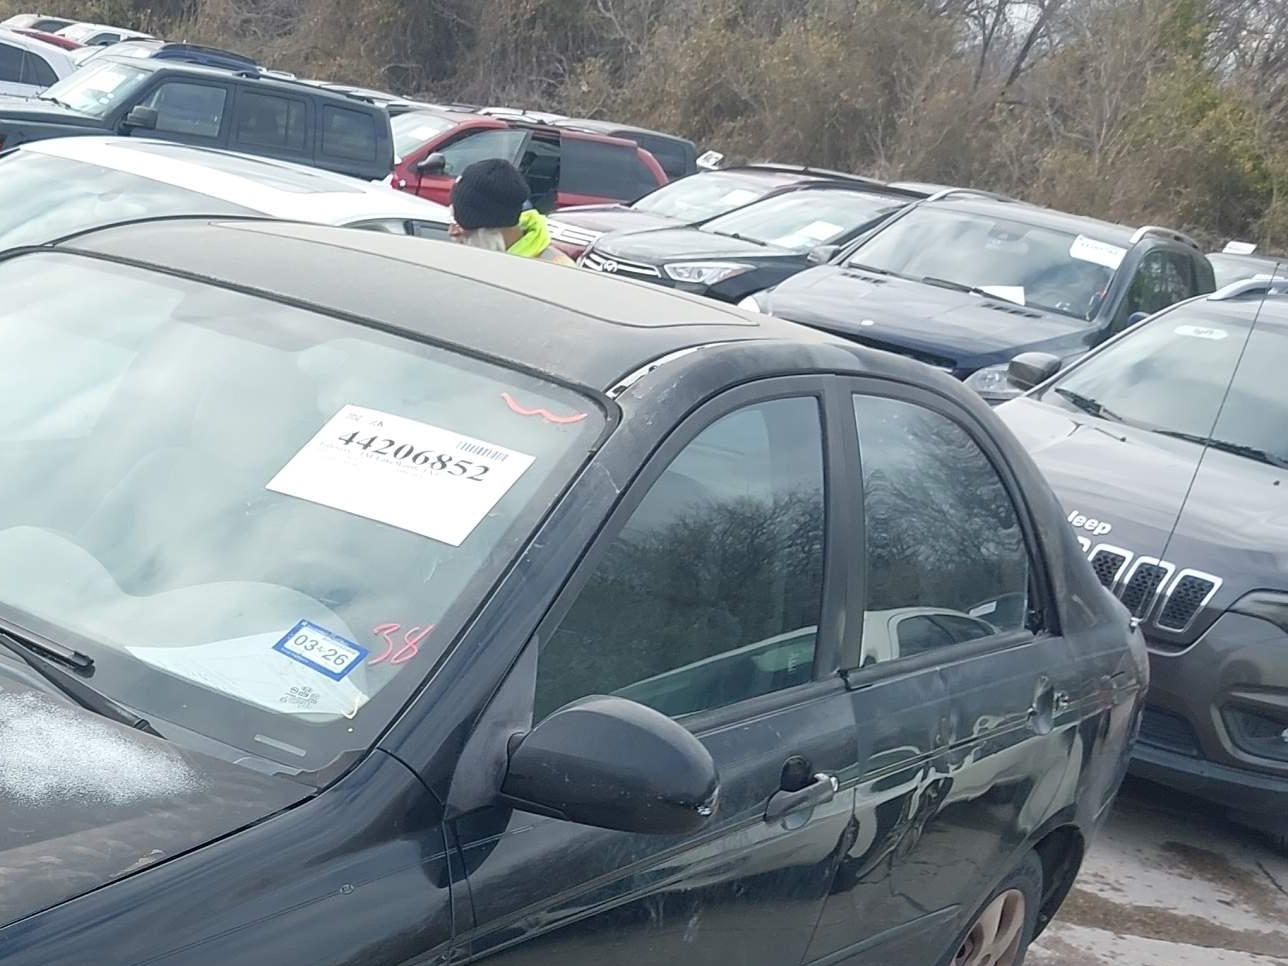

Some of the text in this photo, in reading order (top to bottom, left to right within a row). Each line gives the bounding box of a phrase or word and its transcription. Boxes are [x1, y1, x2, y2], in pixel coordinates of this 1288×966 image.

[337, 431, 491, 482] 44206852
[1067, 510, 1112, 535] Jeep
[367, 623, 437, 665] 38
